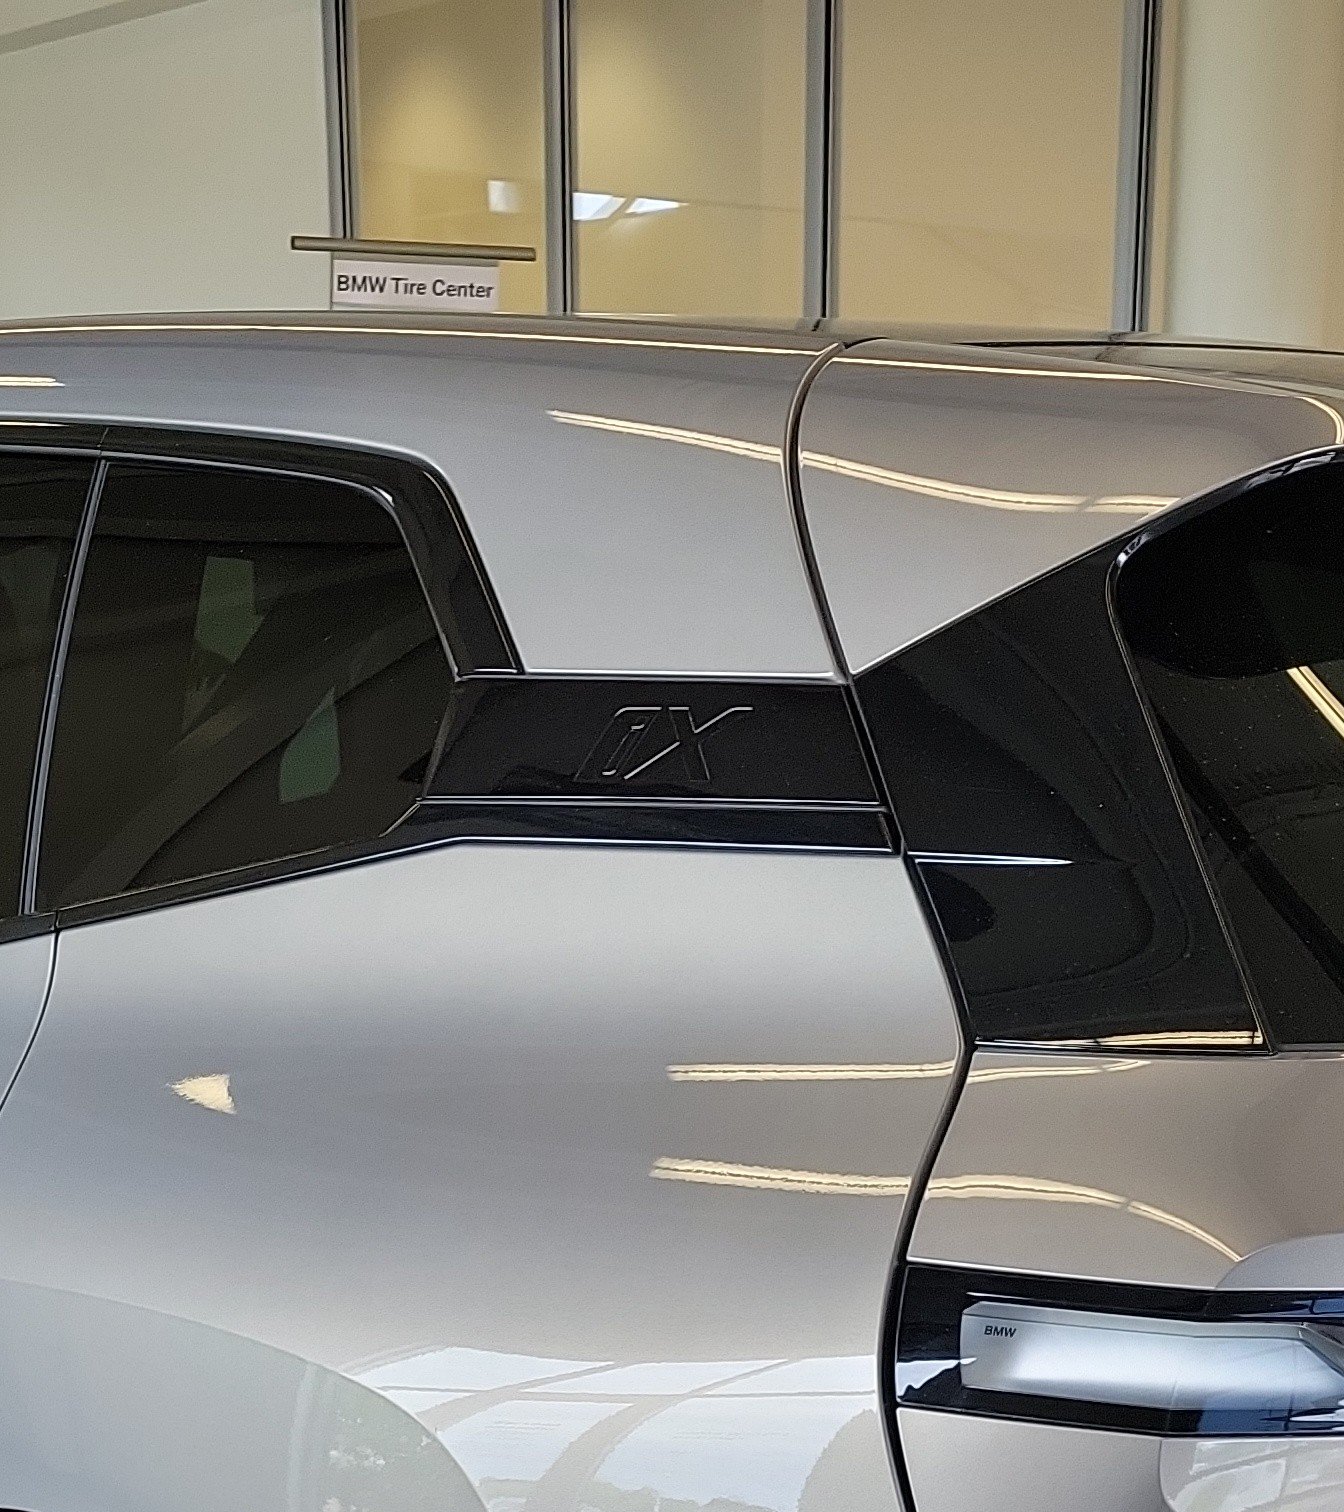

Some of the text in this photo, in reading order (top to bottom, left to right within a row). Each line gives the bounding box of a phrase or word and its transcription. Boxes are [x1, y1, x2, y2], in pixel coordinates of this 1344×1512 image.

[336, 274, 495, 299] BMW Tire Center
[983, 1325, 1017, 1338] BMW
